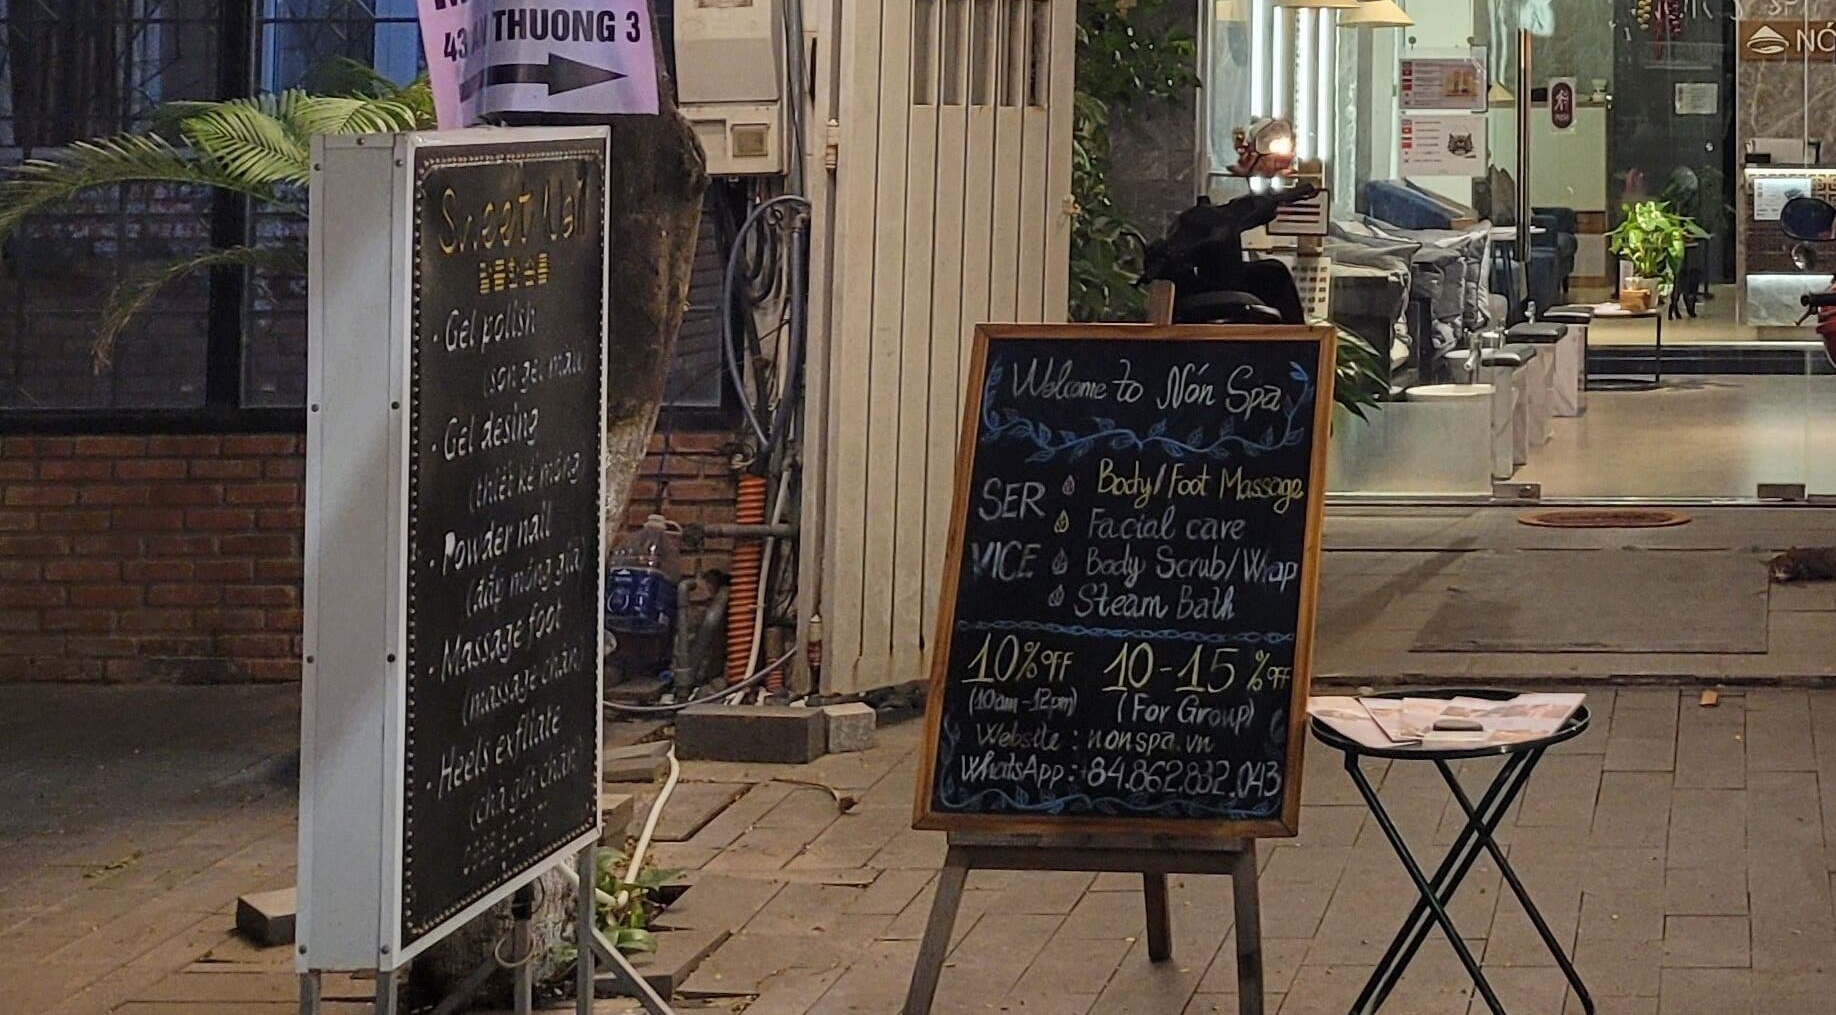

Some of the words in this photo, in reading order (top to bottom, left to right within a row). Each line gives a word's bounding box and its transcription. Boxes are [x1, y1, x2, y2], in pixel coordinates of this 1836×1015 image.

[443, 27, 468, 62] 43
[492, 8, 616, 43] THUONG
[625, 11, 641, 43] 3
[445, 308, 476, 352] Gel
[1013, 357, 1107, 401] Welcome
[1111, 358, 1144, 403] to
[1225, 365, 1282, 421] Spa
[444, 416, 476, 461] Gel
[978, 478, 1047, 522] SER
[1219, 466, 1304, 514] Massage
[1088, 505, 1176, 539] Facial
[1186, 517, 1246, 540] care
[443, 520, 513, 577] Powder
[971, 541, 1042, 582] VICE
[1086, 543, 1146, 588] Body
[1074, 582, 1168, 617] Steam
[1176, 584, 1236, 621] Bath
[440, 621, 523, 683] Massage
[976, 721, 1061, 751] Website
[1177, 694, 1255, 734] Group)
[438, 736, 490, 801] Heels
